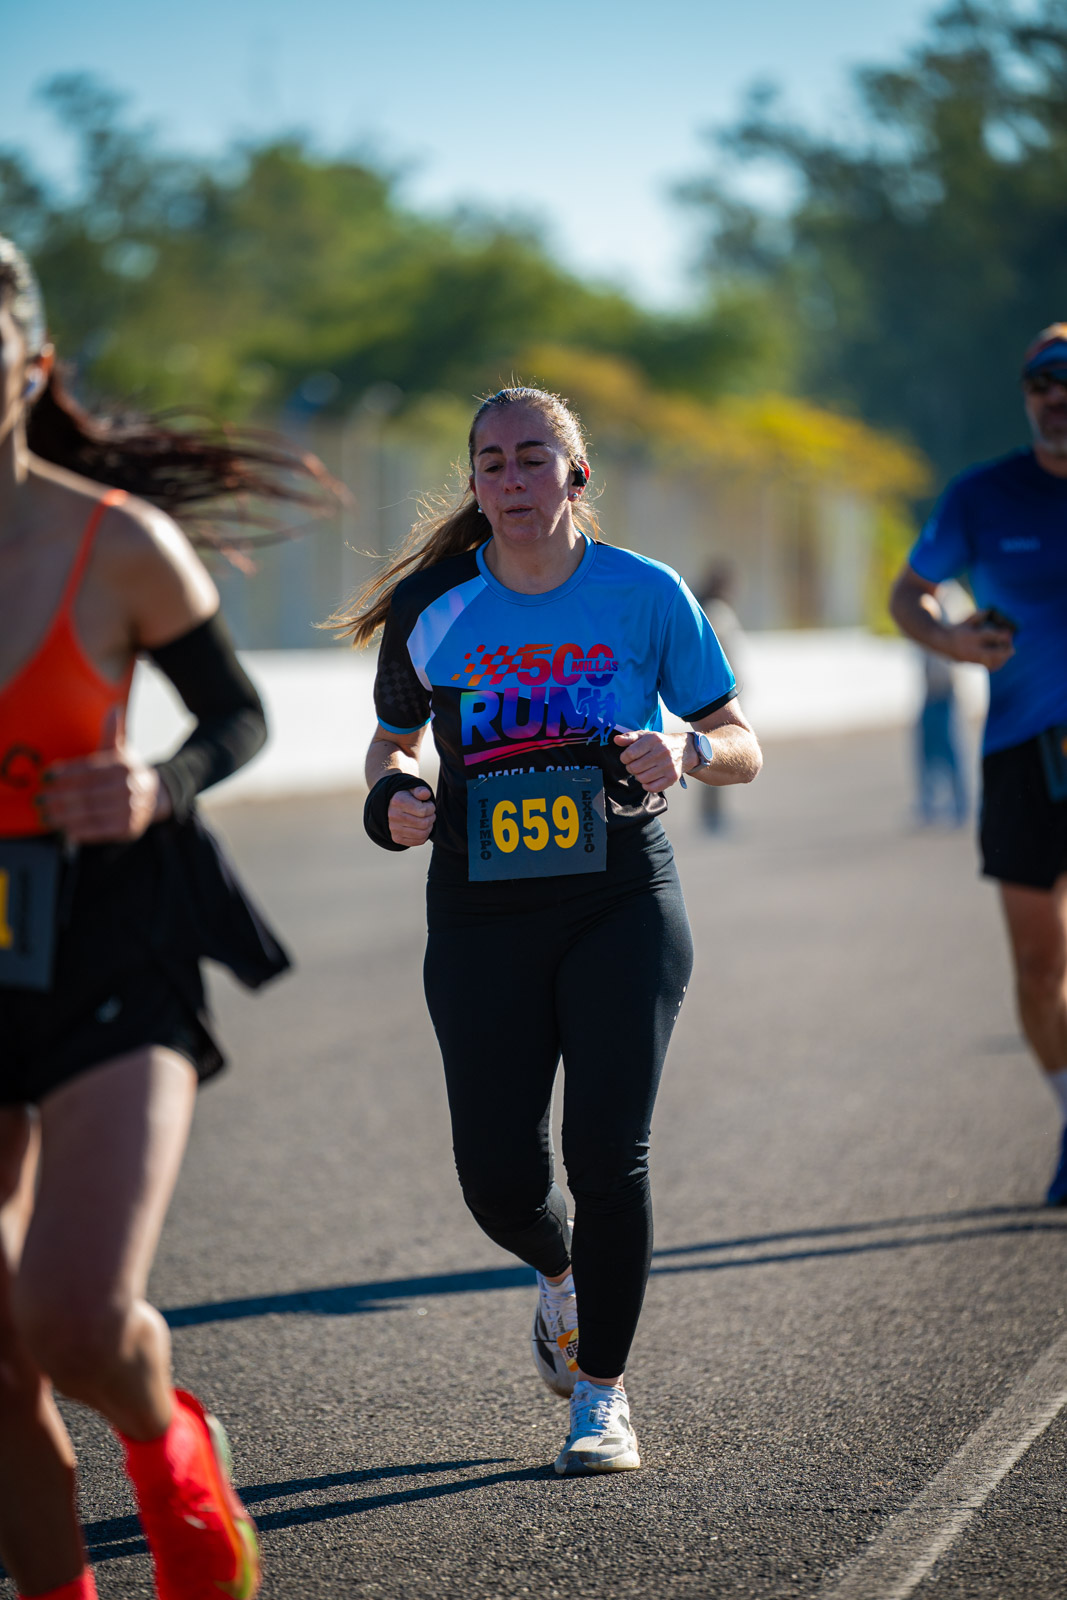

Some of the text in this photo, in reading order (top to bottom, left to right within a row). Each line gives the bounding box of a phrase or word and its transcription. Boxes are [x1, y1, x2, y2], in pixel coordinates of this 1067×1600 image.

[517, 643, 614, 687] 500
[572, 660, 619, 672] MILLAS
[460, 686, 592, 746] RUN
[478, 798, 492, 860] TIEMPO
[492, 795, 580, 853] 659
[581, 790, 595, 853] EXACTO
